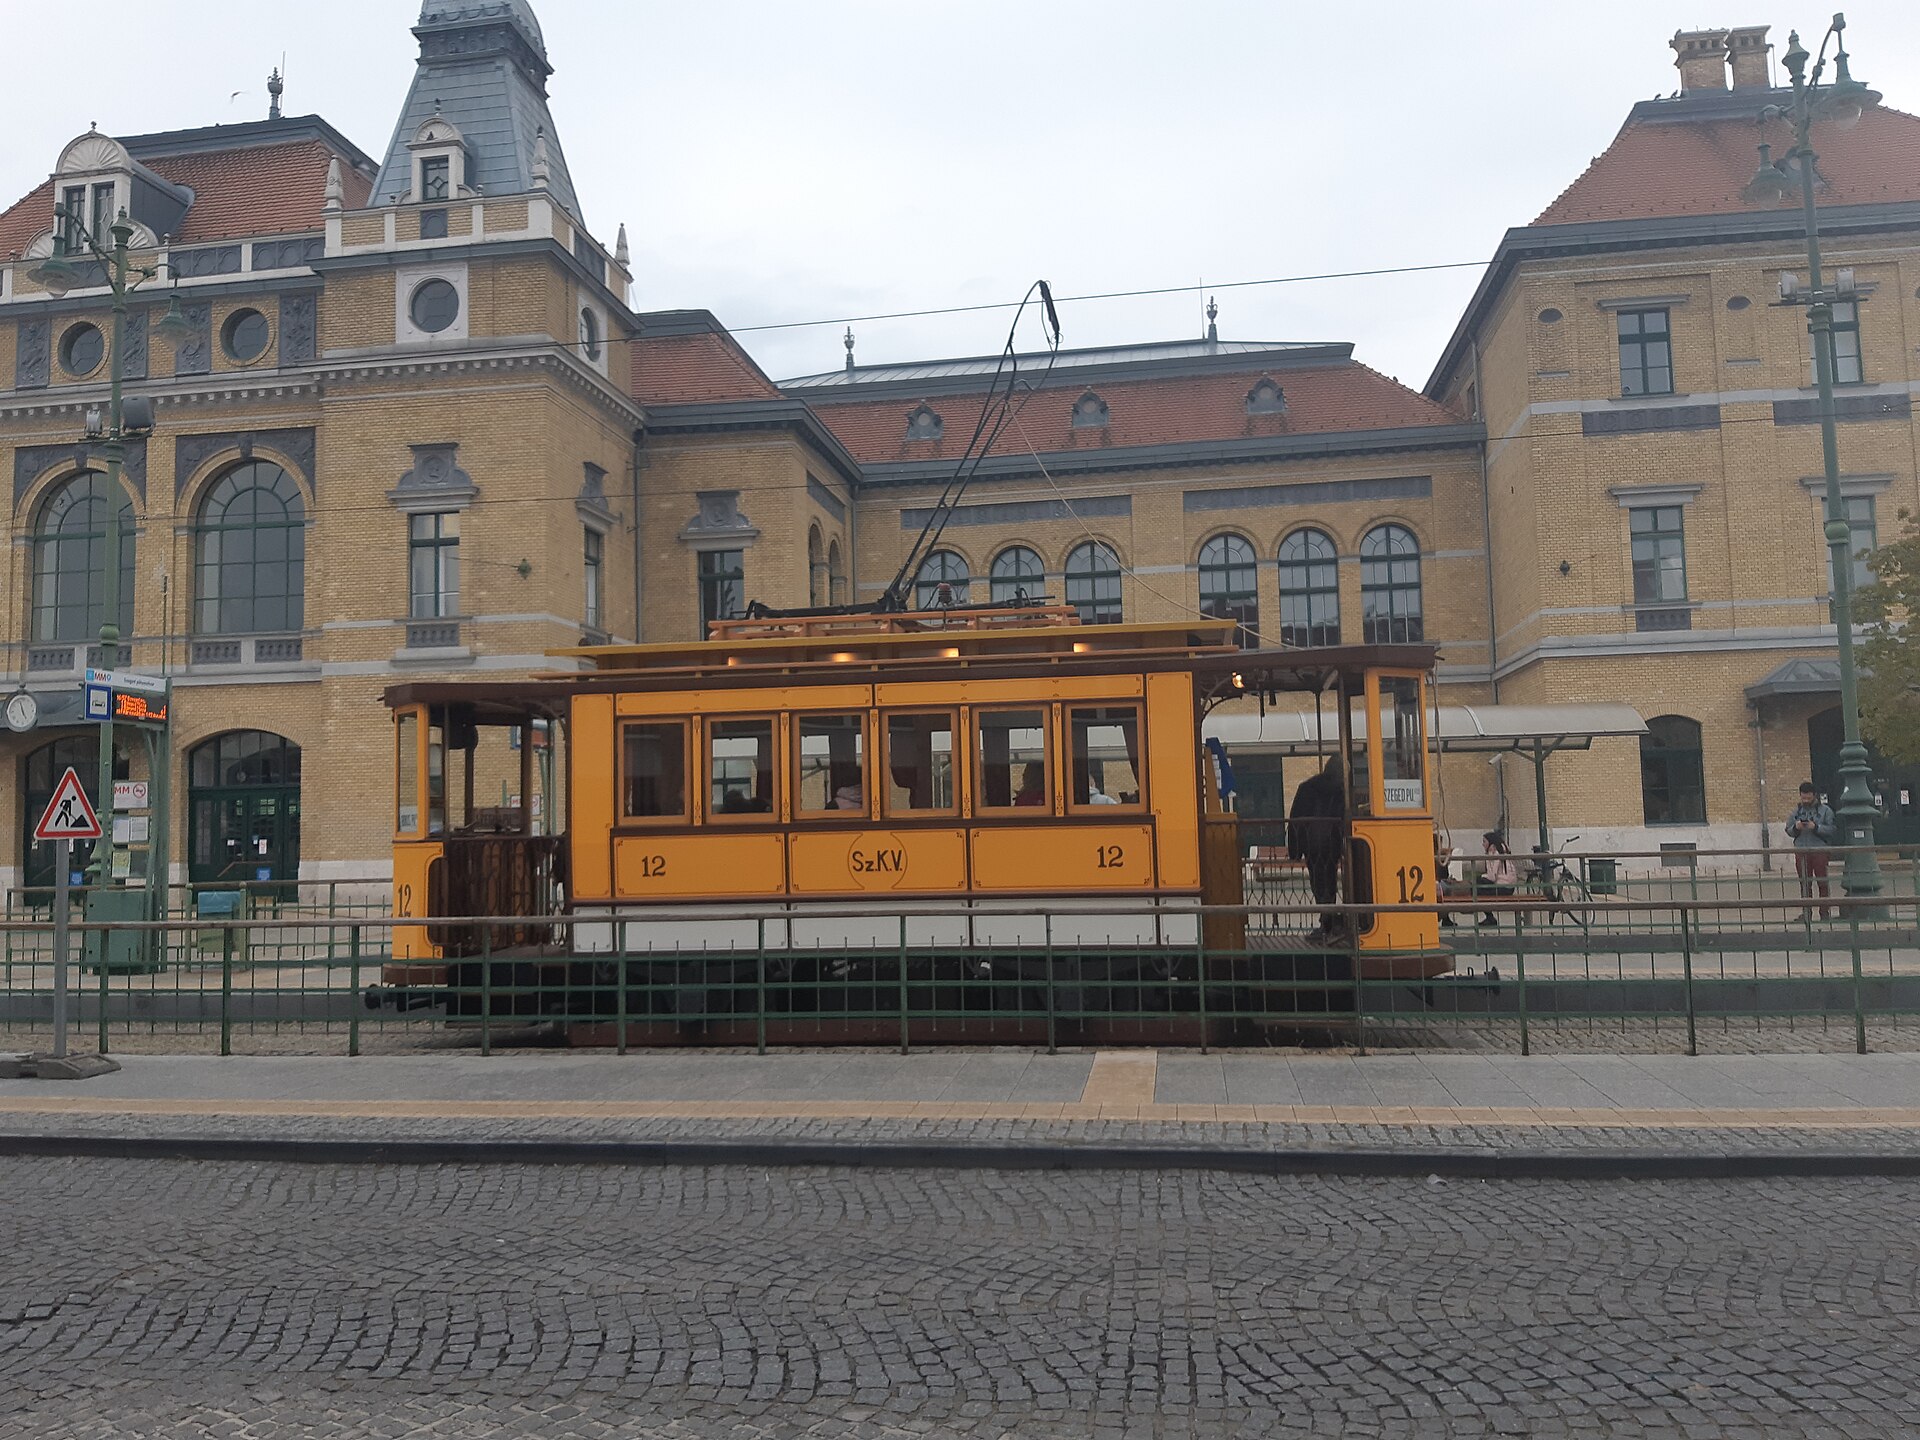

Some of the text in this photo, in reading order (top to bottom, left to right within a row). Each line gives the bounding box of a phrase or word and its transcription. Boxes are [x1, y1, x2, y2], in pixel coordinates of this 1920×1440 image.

[1384, 788, 1406, 802] SZEGED
[641, 855, 666, 877] 12
[1097, 845, 1124, 868] 12
[1396, 865, 1425, 903] 12
[398, 884, 411, 917] 12
